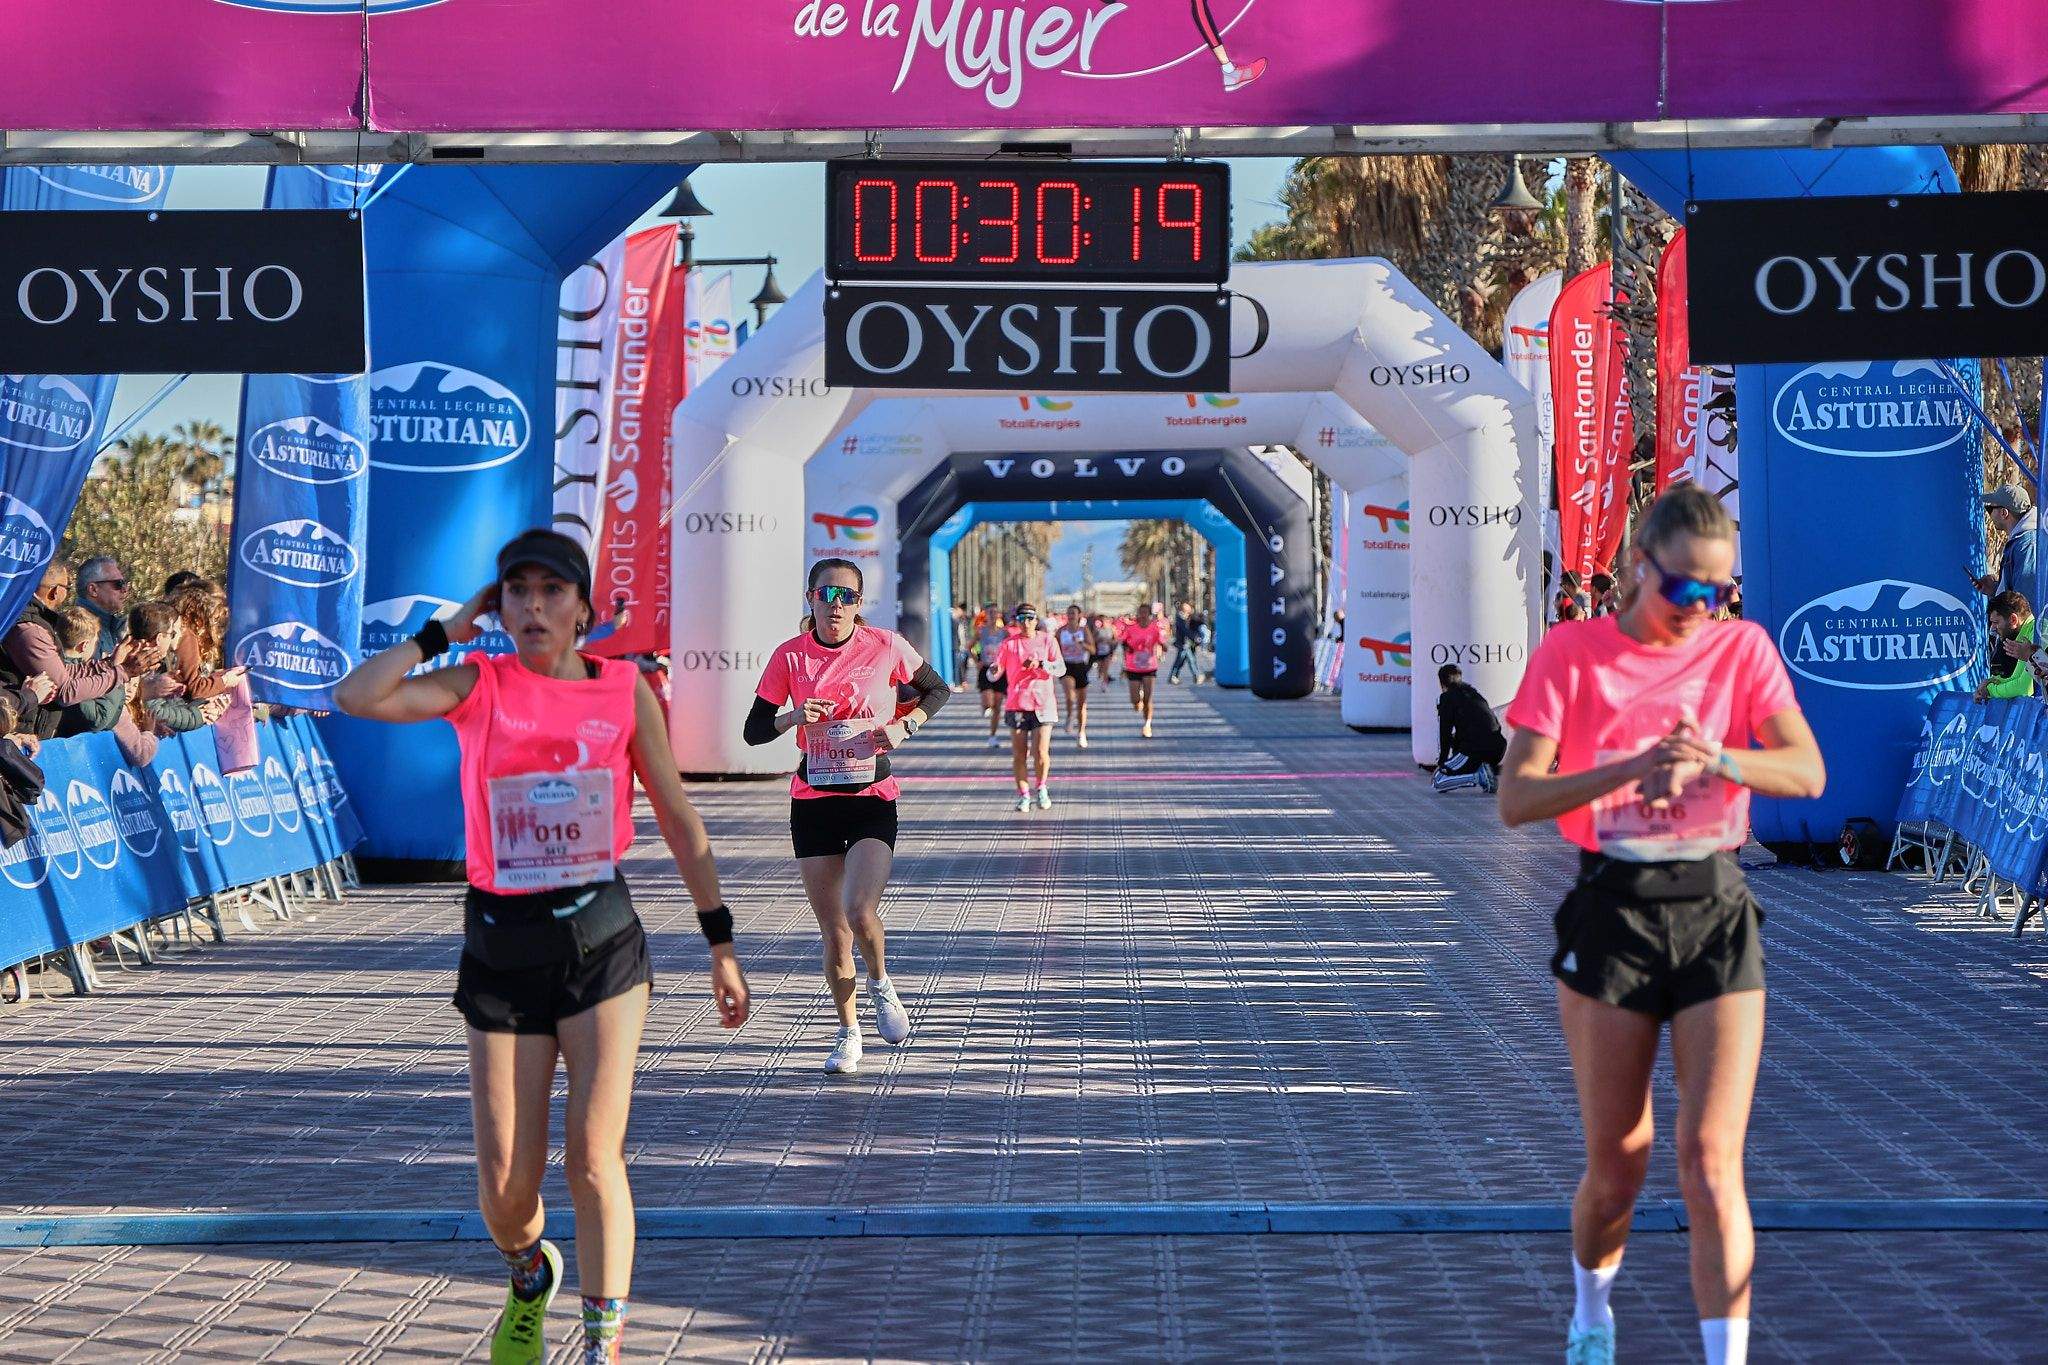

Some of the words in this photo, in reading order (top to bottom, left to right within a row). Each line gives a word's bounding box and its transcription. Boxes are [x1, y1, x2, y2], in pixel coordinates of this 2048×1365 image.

[794, 0, 848, 37] de
[861, 0, 900, 37] la
[891, 0, 1128, 108] Mujer
[853, 179, 1202, 265] 00:30:19
[17, 264, 303, 325] OYSHO
[1755, 249, 2047, 315] OYSHO
[845, 300, 1213, 378] OYSHO
[609, 280, 650, 463] Santander
[1371, 363, 1471, 387] OYSHO
[731, 376, 831, 398] OYSHO
[1571, 317, 1599, 475] Santander
[1818, 385, 1892, 397] CENTRAL
[370, 398, 437, 411] ENTRAL
[445, 401, 514, 415] LECHERA
[1165, 414, 1248, 428] TotalEnergies
[1786, 390, 1965, 431] ASTURIANA
[999, 418, 1081, 431] TotalEnergies
[258, 434, 358, 472] ASTURIANA
[983, 456, 1186, 479] VOLVO
[685, 512, 777, 534] OYSHO
[1429, 504, 1522, 527] OYSHO
[251, 538, 349, 575] ASTURIANA
[1269, 534, 1288, 680] VOLVO
[1825, 617, 1899, 629] CENTRAL
[1906, 615, 1966, 627] LECHERA
[1431, 642, 1524, 665] OYSHO
[1793, 621, 1972, 662] ASTURIANA
[245, 641, 340, 678] ASTURIANA
[829, 748, 855, 760] 016
[535, 822, 581, 843] 016
